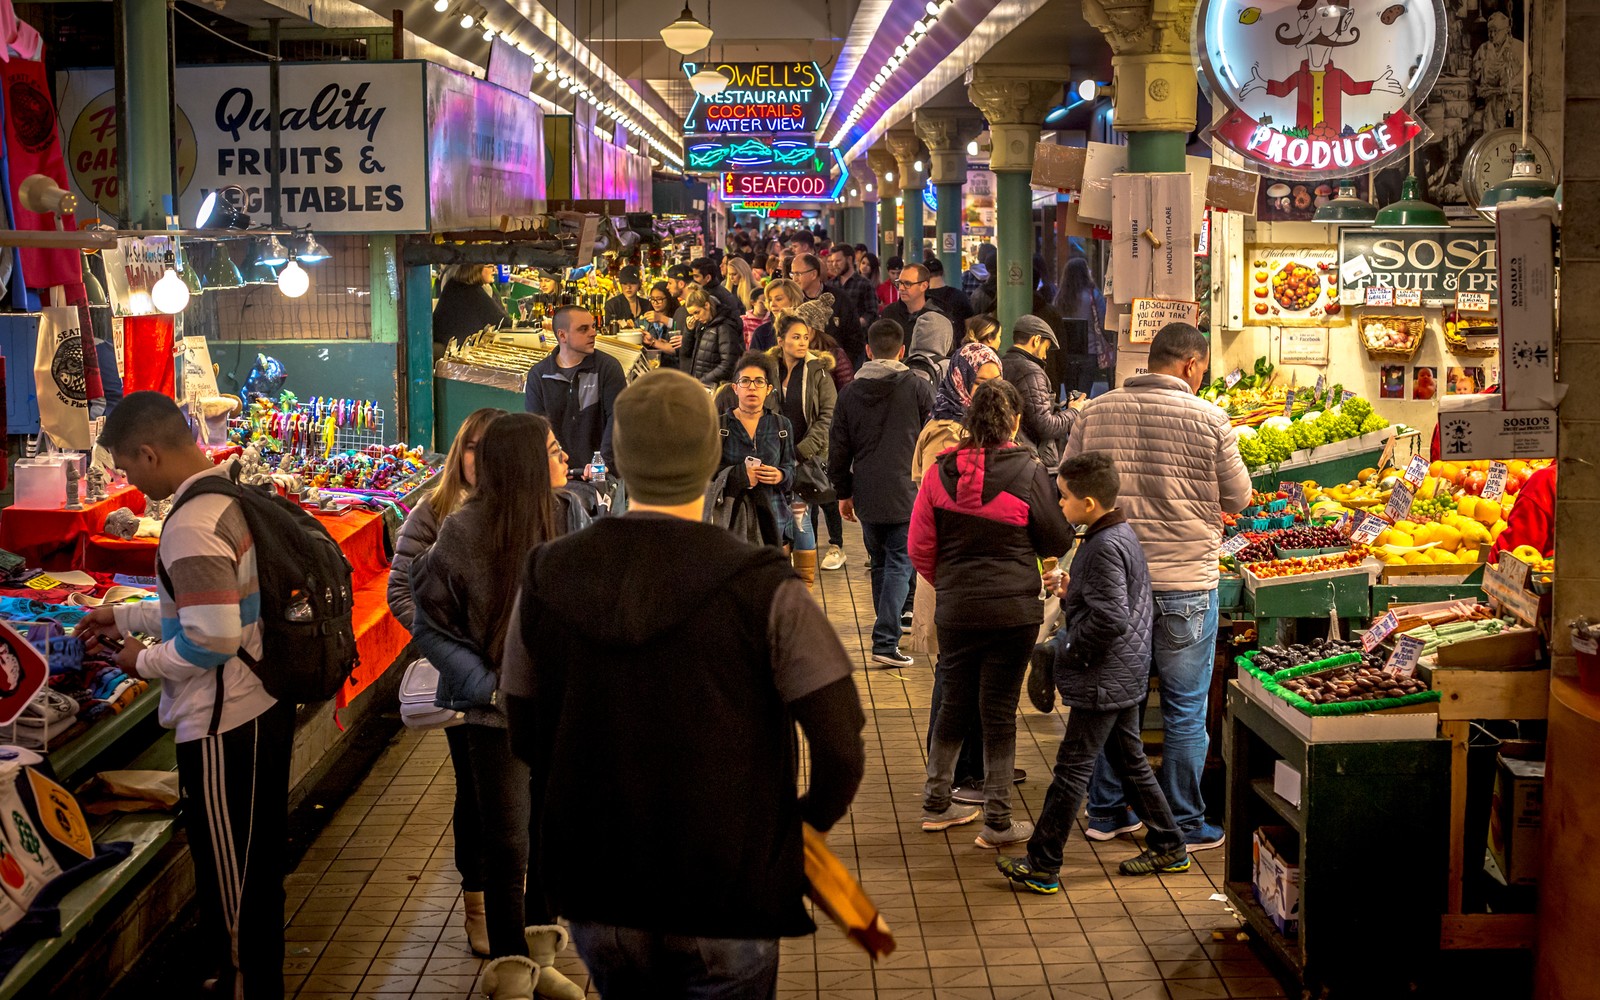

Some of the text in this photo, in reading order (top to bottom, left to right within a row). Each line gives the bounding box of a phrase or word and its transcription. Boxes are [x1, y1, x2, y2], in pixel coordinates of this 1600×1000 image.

[704, 89, 812, 104] RESTAURANT
[215, 82, 387, 142] Quality
[707, 104, 803, 118] COCKTAILS
[706, 118, 806, 131] WATER VIEW
[1246, 123, 1398, 169] PRODUCE
[218, 146, 386, 176] FRUITS &
[1483, 162, 1491, 173] 2
[741, 176, 825, 195] SEAFOOD
[744, 201, 778, 209] GROCERY
[1131, 219, 1139, 259] PERISHABLE
[1261, 247, 1296, 258] Heirloom
[1355, 272, 1438, 291] FRUIT
[1443, 273, 1459, 291] &
[1139, 301, 1192, 315] ABSOLUTELY
[1137, 311, 1187, 320] YOU CAN TAKE
[1138, 319, 1162, 328] FRUIT
[1134, 330, 1147, 338] THE
[1503, 417, 1550, 427] SOSIO'S
